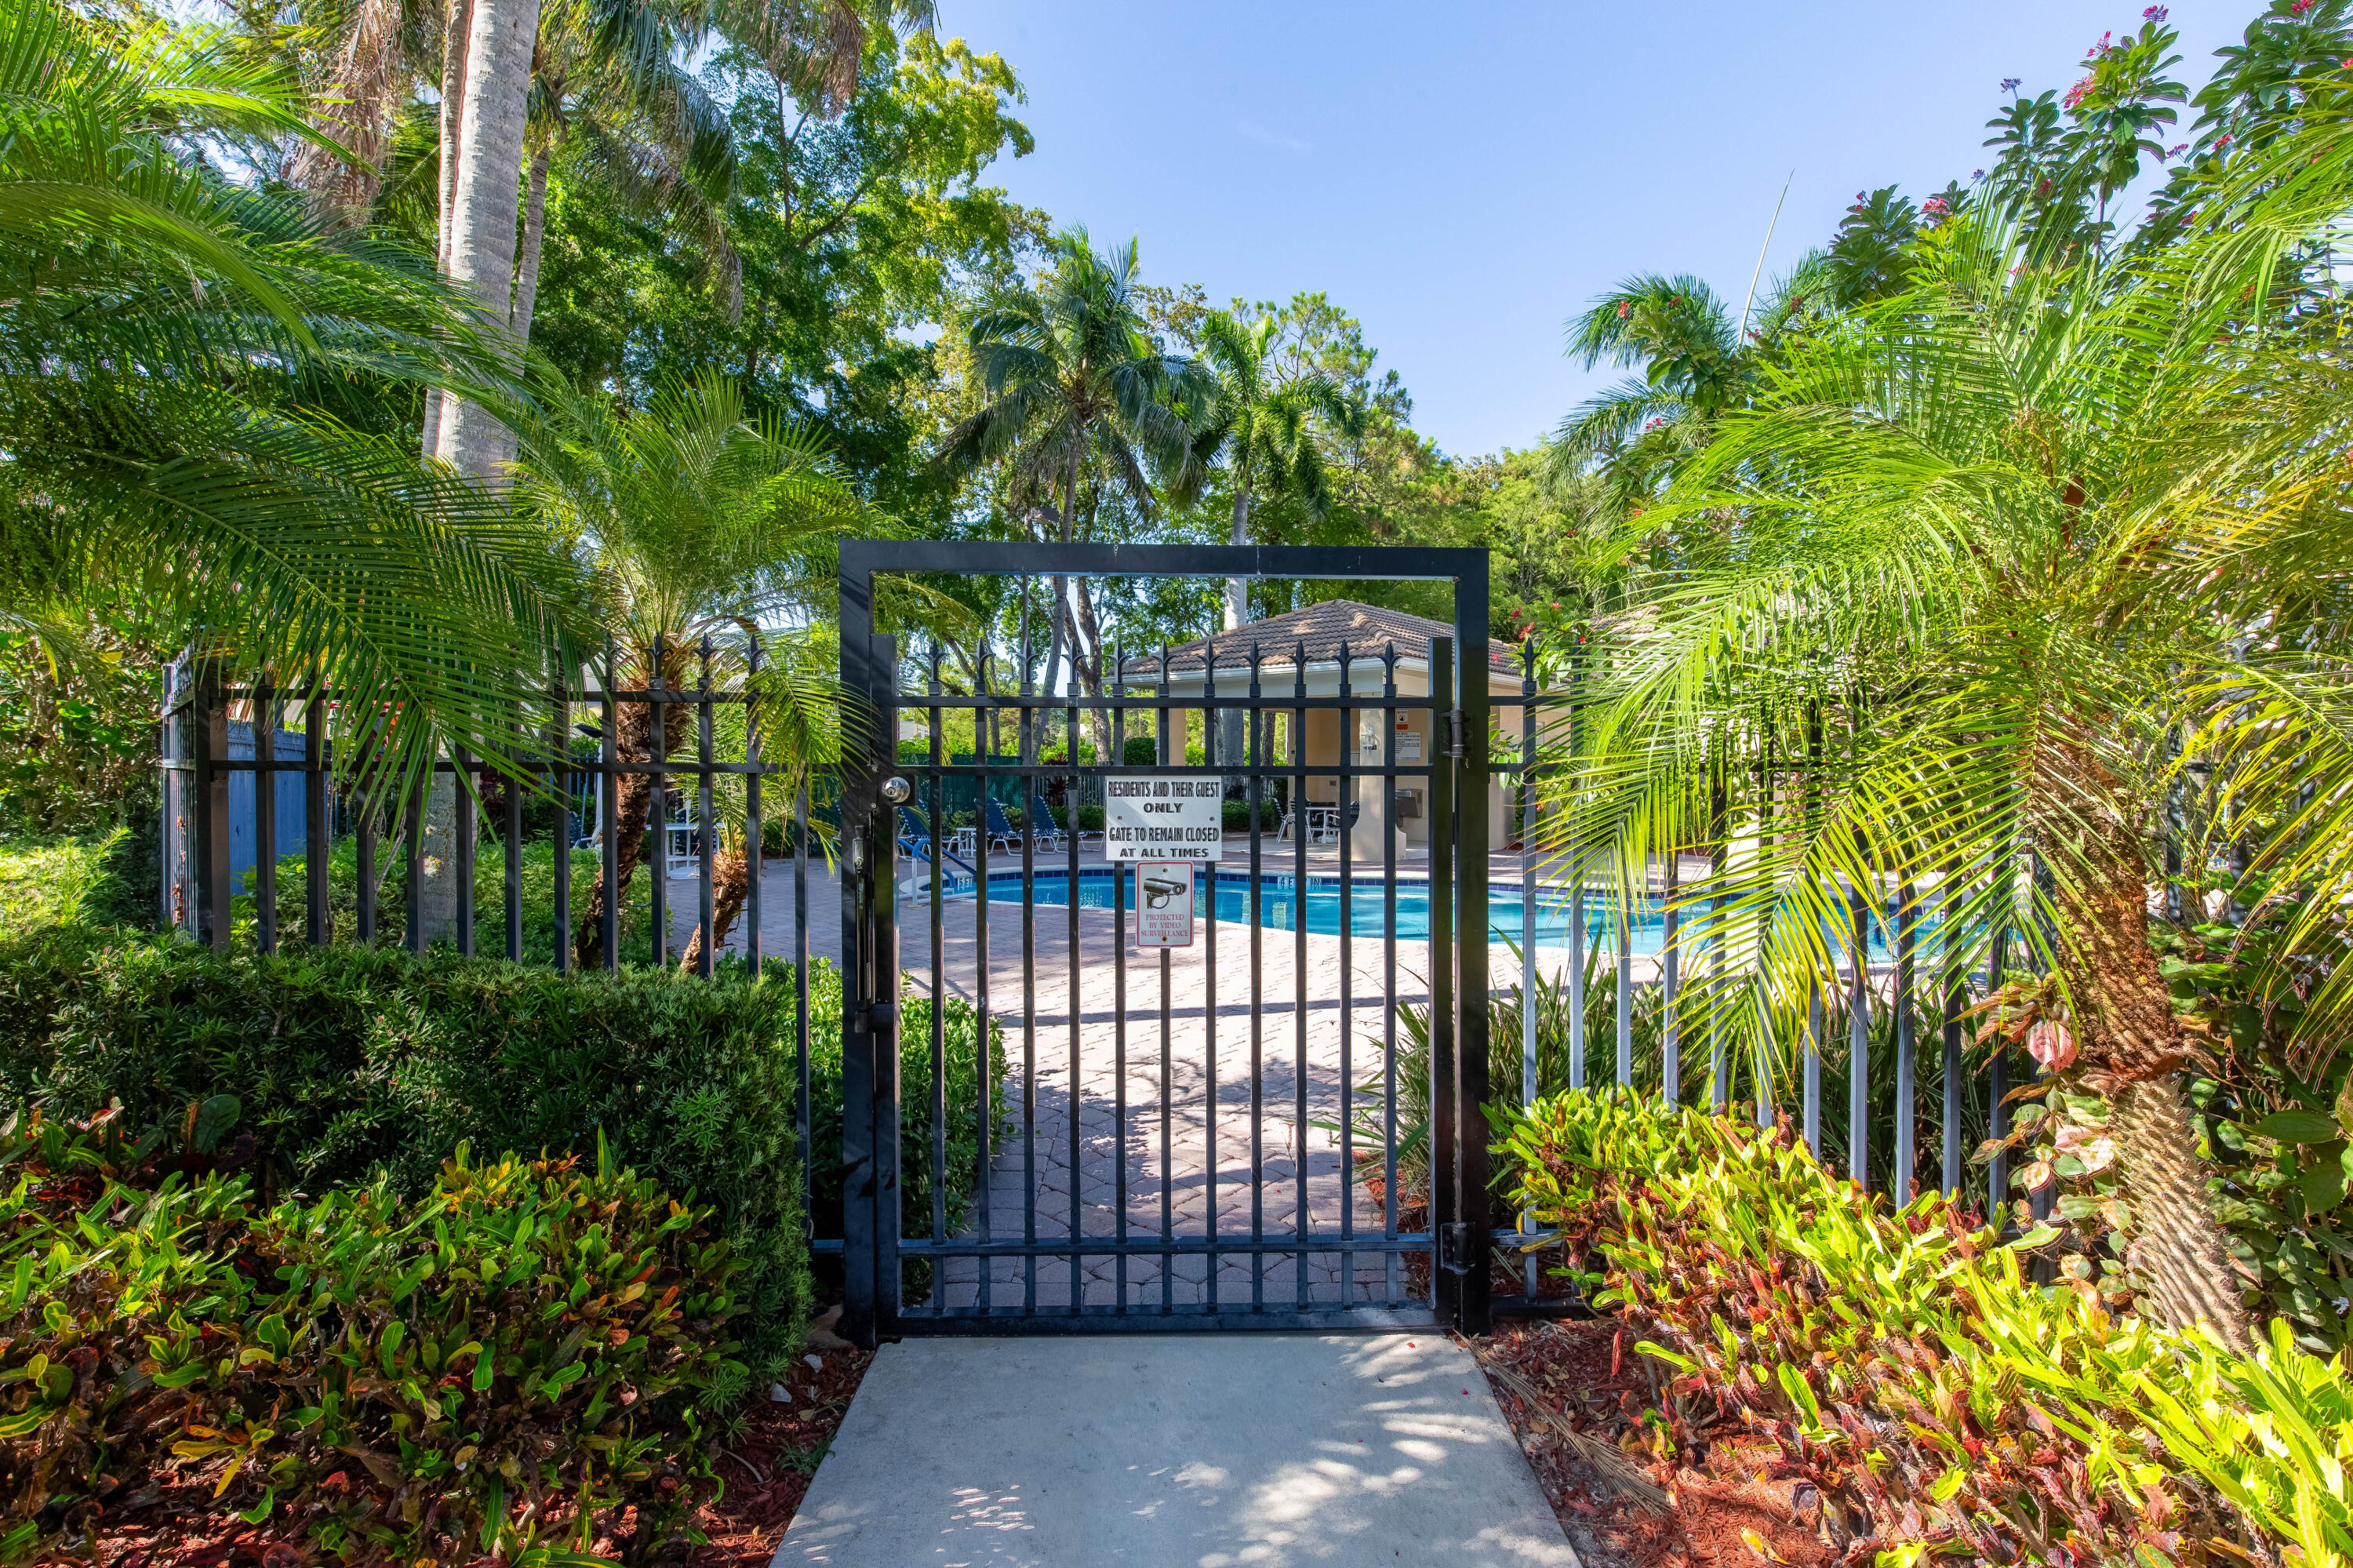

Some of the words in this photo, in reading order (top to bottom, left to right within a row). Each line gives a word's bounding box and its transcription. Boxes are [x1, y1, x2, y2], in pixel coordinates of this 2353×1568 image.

[1108, 781, 1151, 798] RESIDENTS
[1153, 781, 1169, 798] AND
[1171, 781, 1194, 798] THEIR
[1196, 781, 1220, 798] GUEST
[1144, 802, 1184, 813] ONLY
[1109, 828, 1132, 842] GATE
[1134, 828, 1147, 842] TO
[1149, 828, 1184, 842] REMAIN
[1185, 828, 1219, 842] CLOSED
[1119, 848, 1136, 857] AT
[1140, 848, 1166, 857] ALL
[1170, 848, 1209, 857] TIMES
